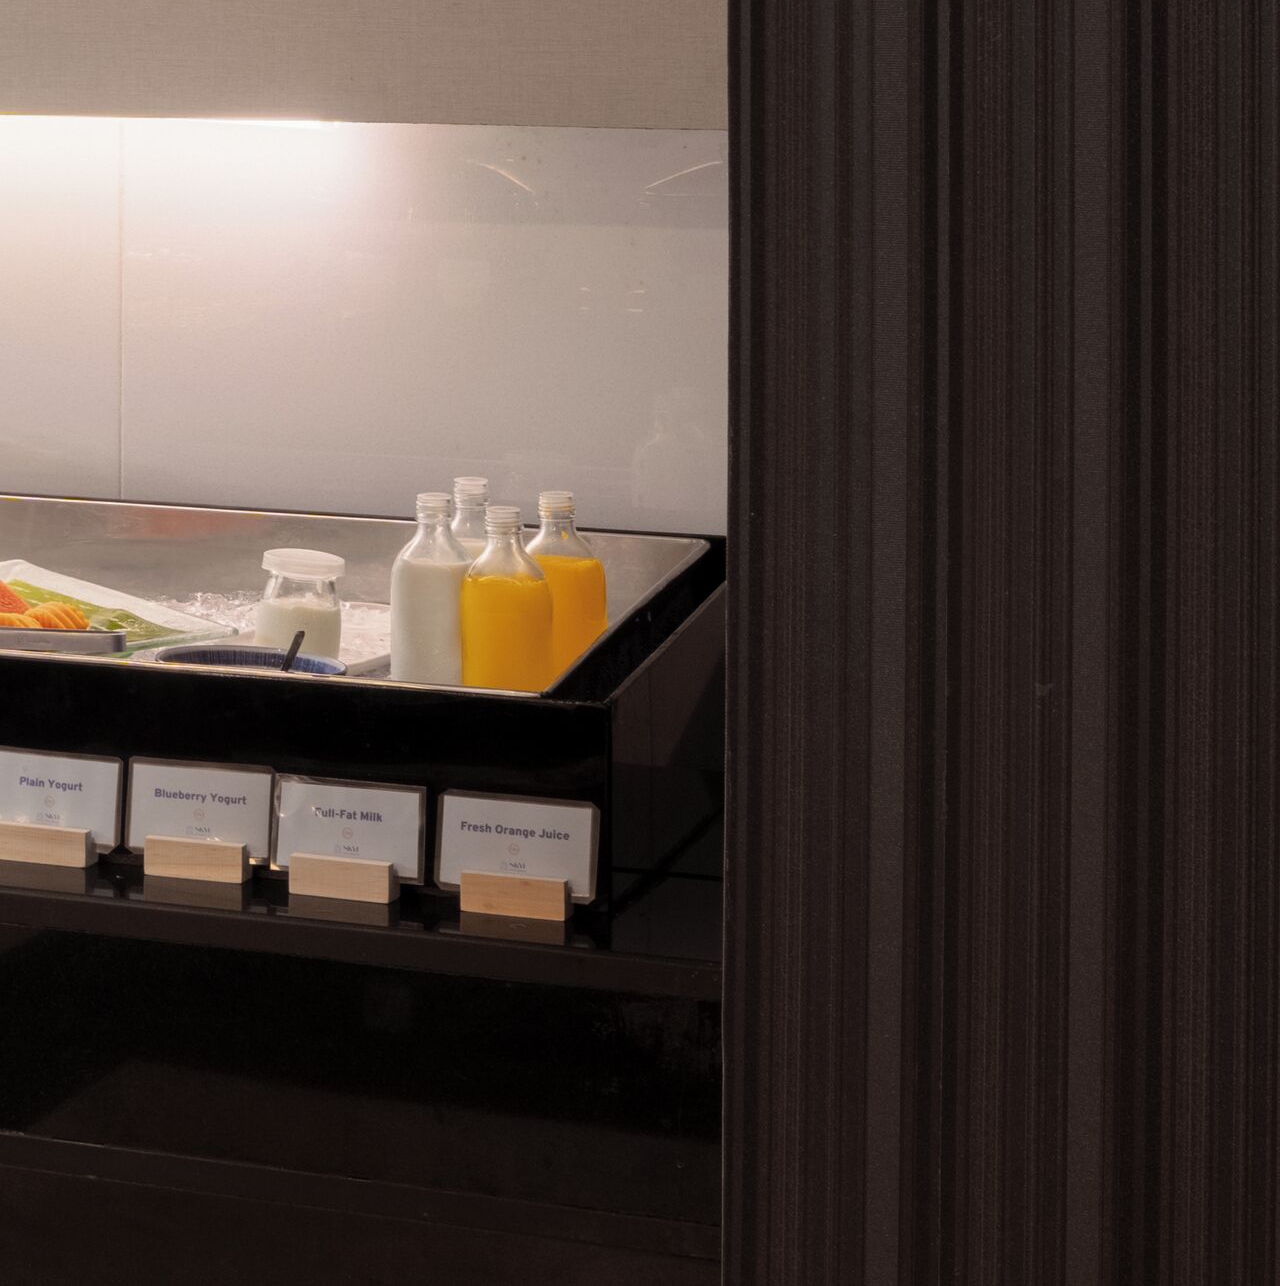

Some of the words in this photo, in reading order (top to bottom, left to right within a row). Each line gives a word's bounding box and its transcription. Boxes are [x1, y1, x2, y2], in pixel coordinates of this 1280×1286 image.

[19, 776, 45, 787] Plain
[48, 779, 83, 792] Yogurt
[154, 788, 207, 804] Blueberry
[209, 792, 247, 805] Yogurt
[314, 807, 357, 820] Full-Fat
[360, 811, 383, 823] Milk
[460, 821, 492, 833] Fresh
[495, 824, 536, 839] Orange
[538, 828, 571, 841] Juice
